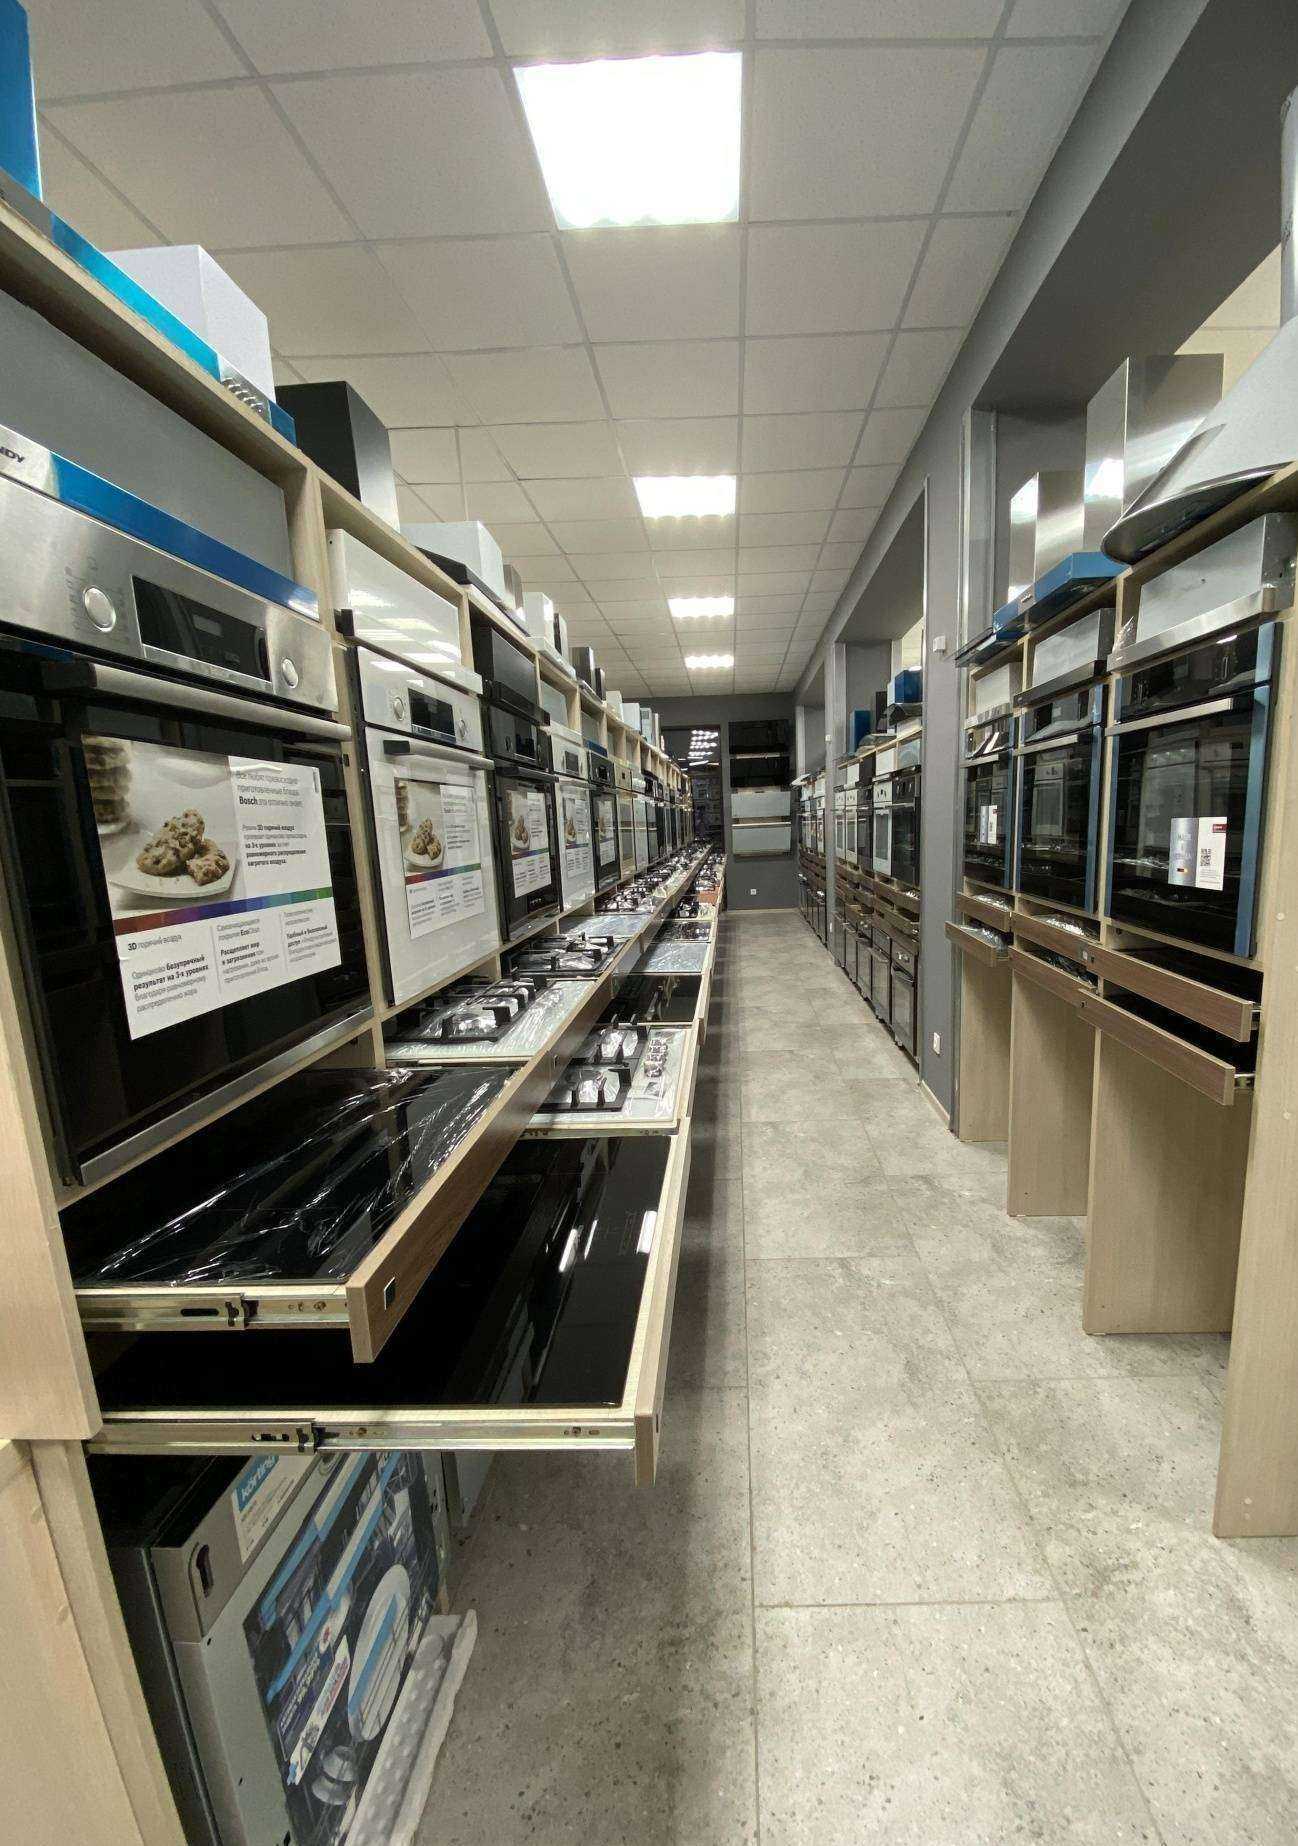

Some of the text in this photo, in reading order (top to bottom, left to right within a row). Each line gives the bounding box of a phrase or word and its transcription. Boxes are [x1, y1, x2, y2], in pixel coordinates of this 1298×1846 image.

[239, 796, 258, 806] Bosch
[127, 942, 138, 951] 3D
[166, 954, 206, 971] безупречный
[133, 976, 166, 992] результат
[167, 973, 175, 982] на
[185, 964, 209, 978] уровнях
